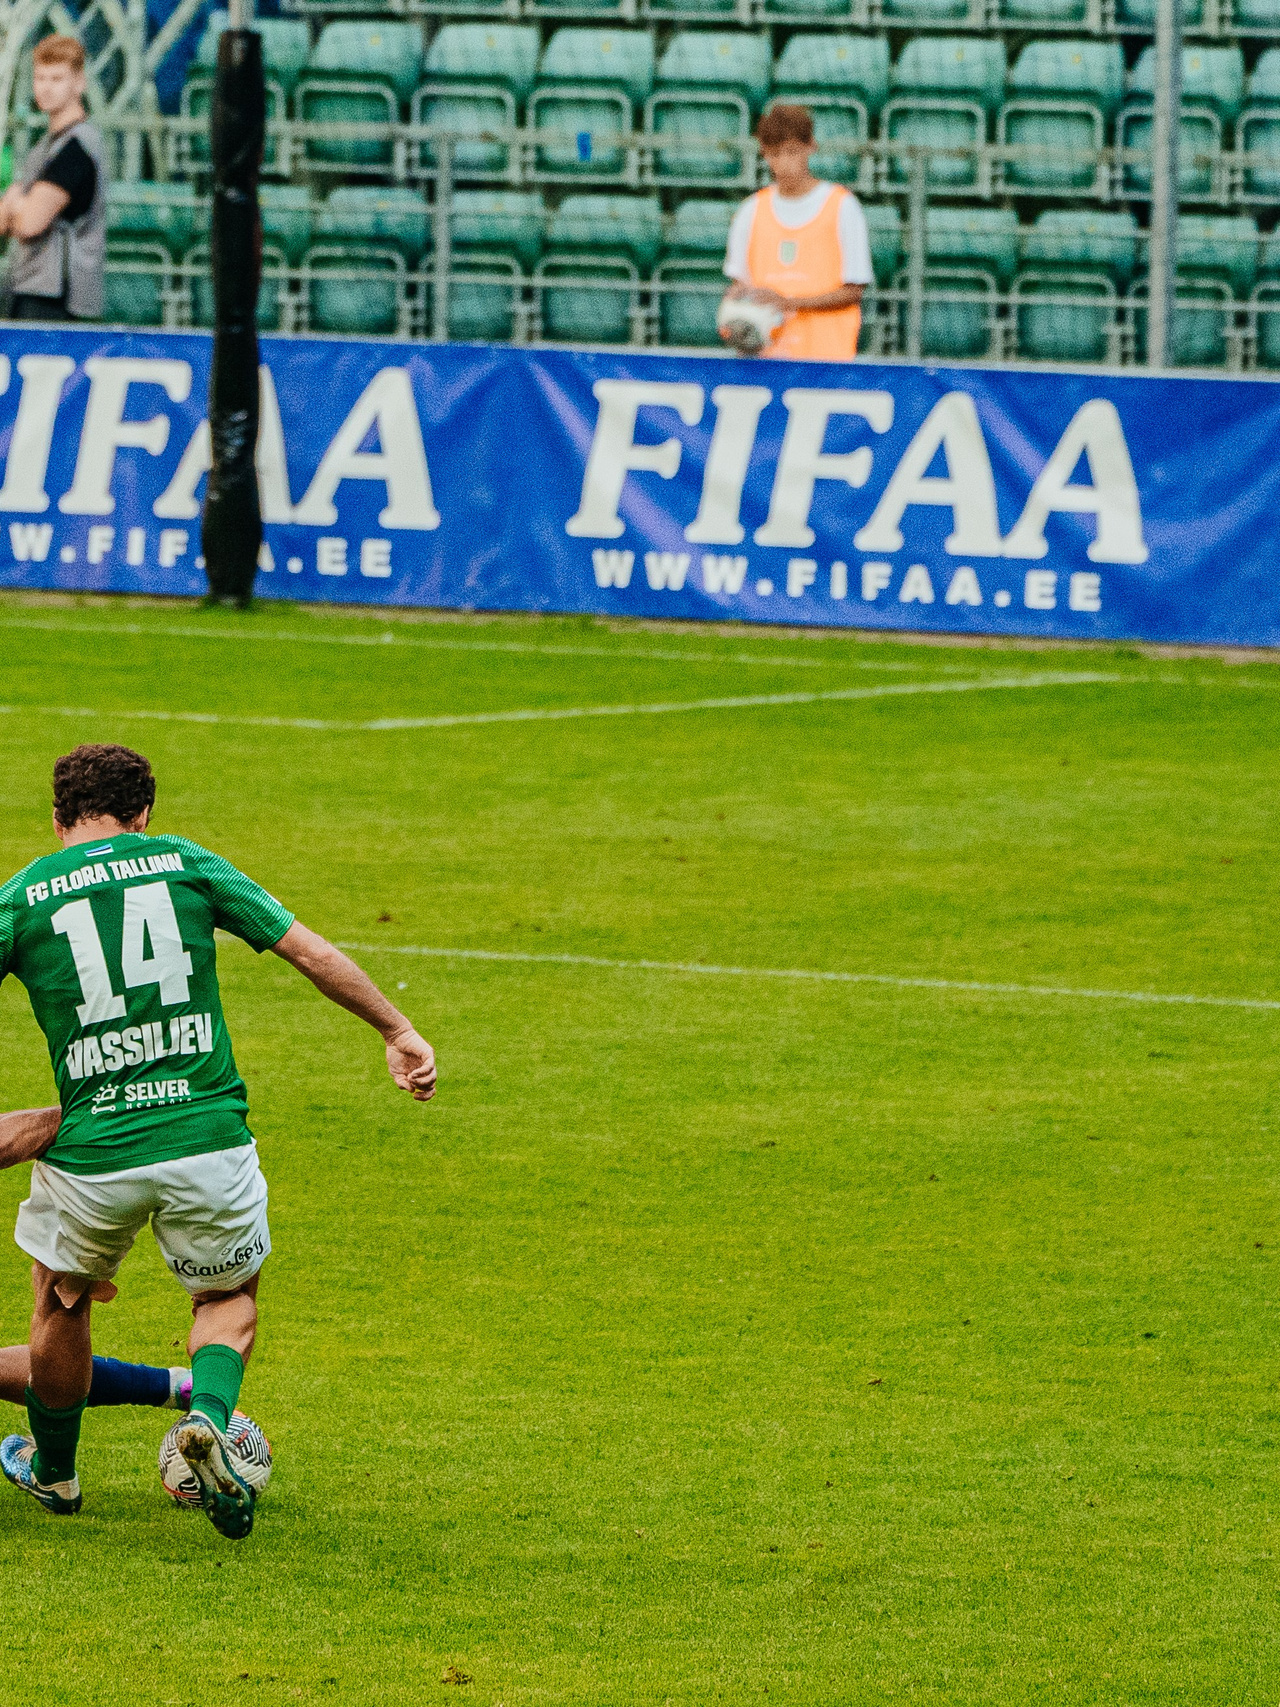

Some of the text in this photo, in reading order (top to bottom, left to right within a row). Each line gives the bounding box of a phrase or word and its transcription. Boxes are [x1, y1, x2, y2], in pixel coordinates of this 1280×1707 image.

[565, 379, 1149, 563] FIFAA
[591, 548, 1102, 612] WWW.FIFAA.EE
[25, 853, 184, 907] FC FLORA TALLINN
[50, 880, 193, 1027] 14
[65, 1012, 213, 1080] VASSILJEV
[124, 1079, 190, 1102] SELVER
